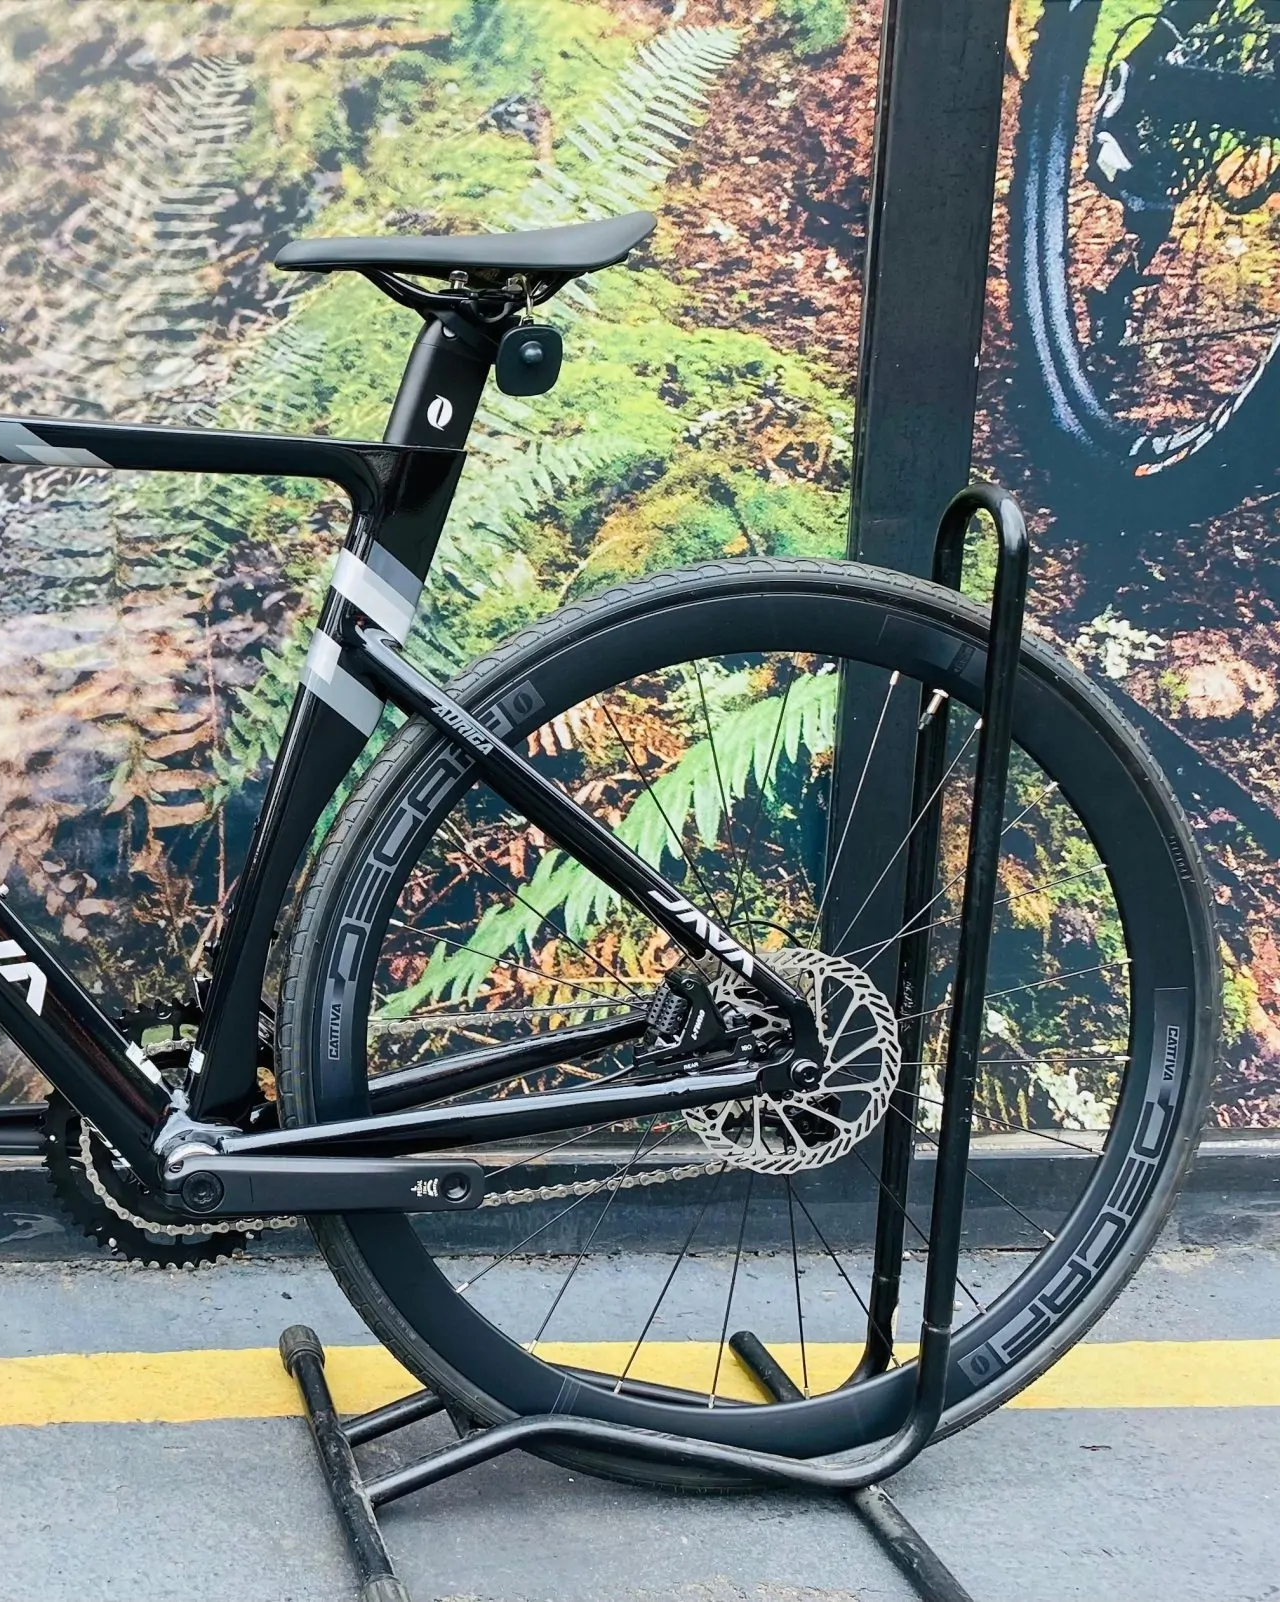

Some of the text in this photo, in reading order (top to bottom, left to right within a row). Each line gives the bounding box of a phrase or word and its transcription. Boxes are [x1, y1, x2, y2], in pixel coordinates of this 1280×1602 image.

[431, 701, 495, 755] AURIGA
[648, 890, 754, 978] JAVA
[328, 1003, 342, 1060] CATTIVA
[1163, 1025, 1180, 1081] CATTIVA
[1002, 1090, 1174, 1360] DECAF
